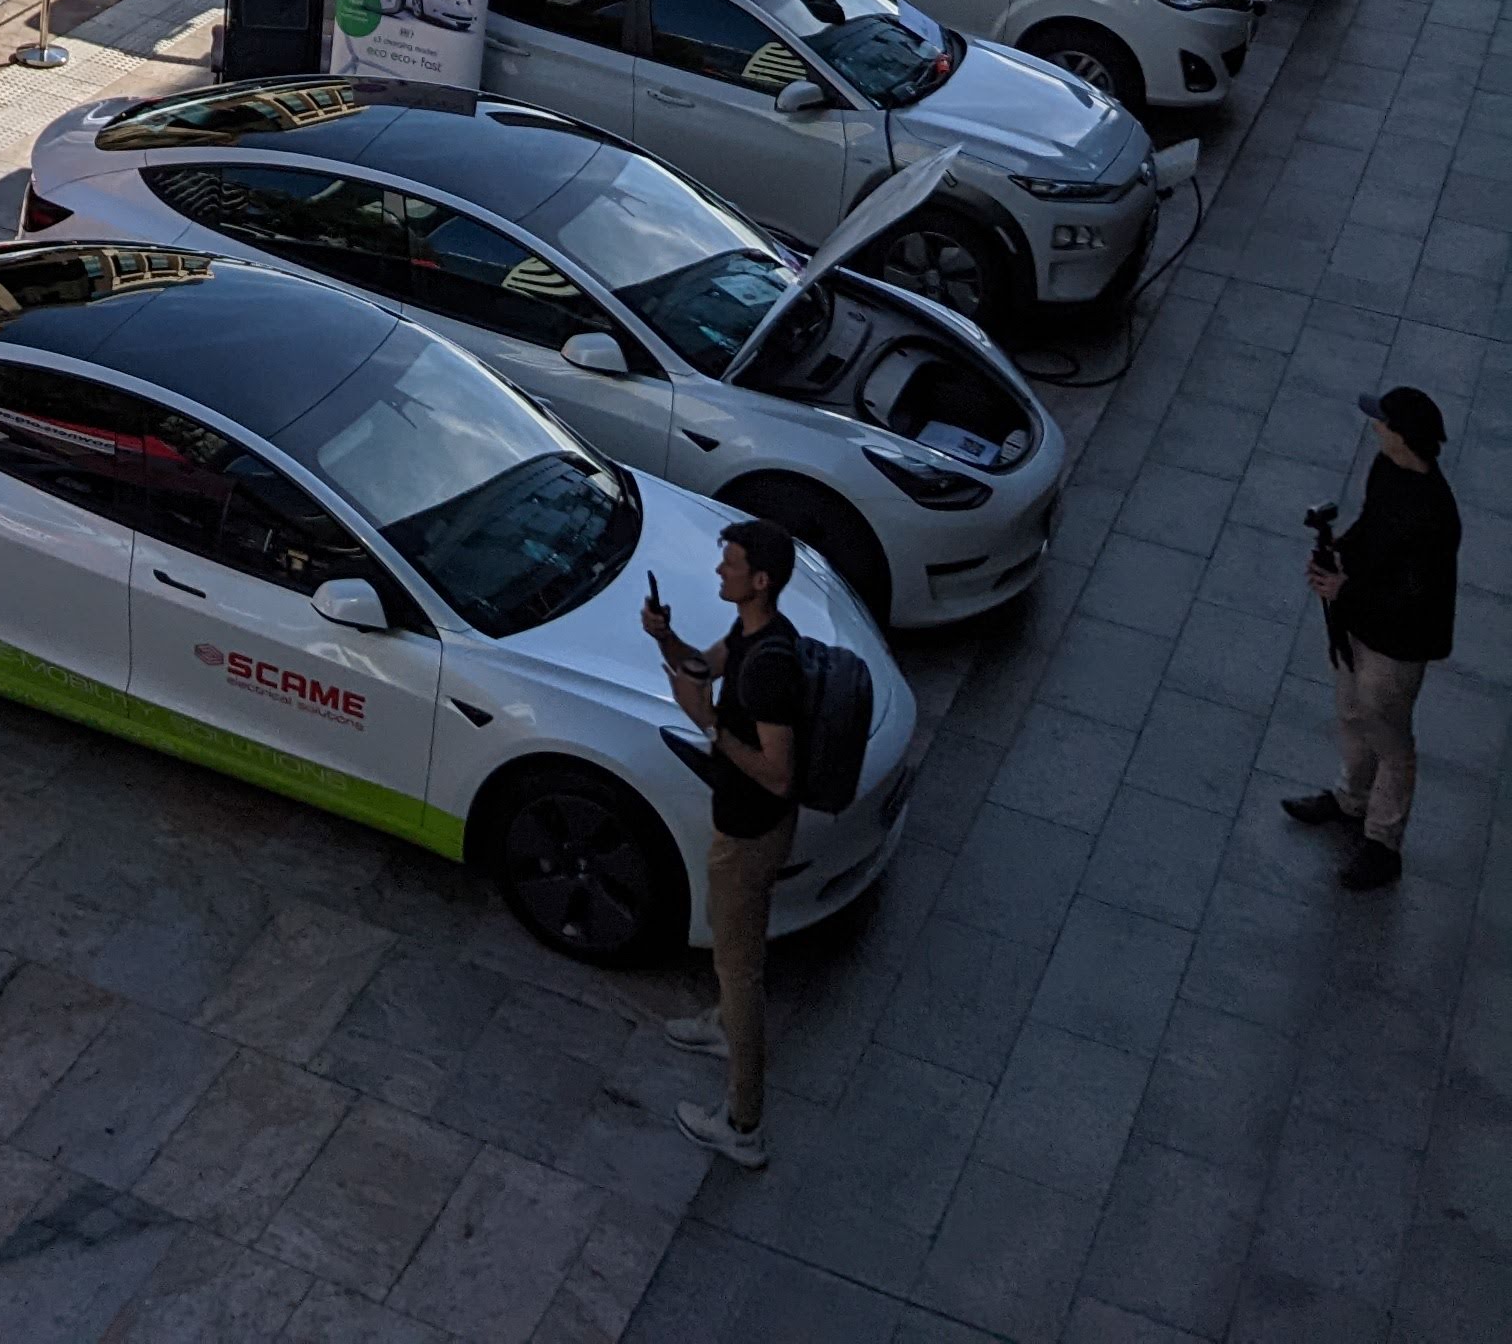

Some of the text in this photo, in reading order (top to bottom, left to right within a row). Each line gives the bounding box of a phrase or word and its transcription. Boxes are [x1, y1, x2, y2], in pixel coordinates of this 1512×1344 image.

[366, 46, 387, 58] eco
[420, 56, 443, 73] fast
[226, 650, 367, 720] SCAME
[226, 675, 366, 732] electrical solutions
